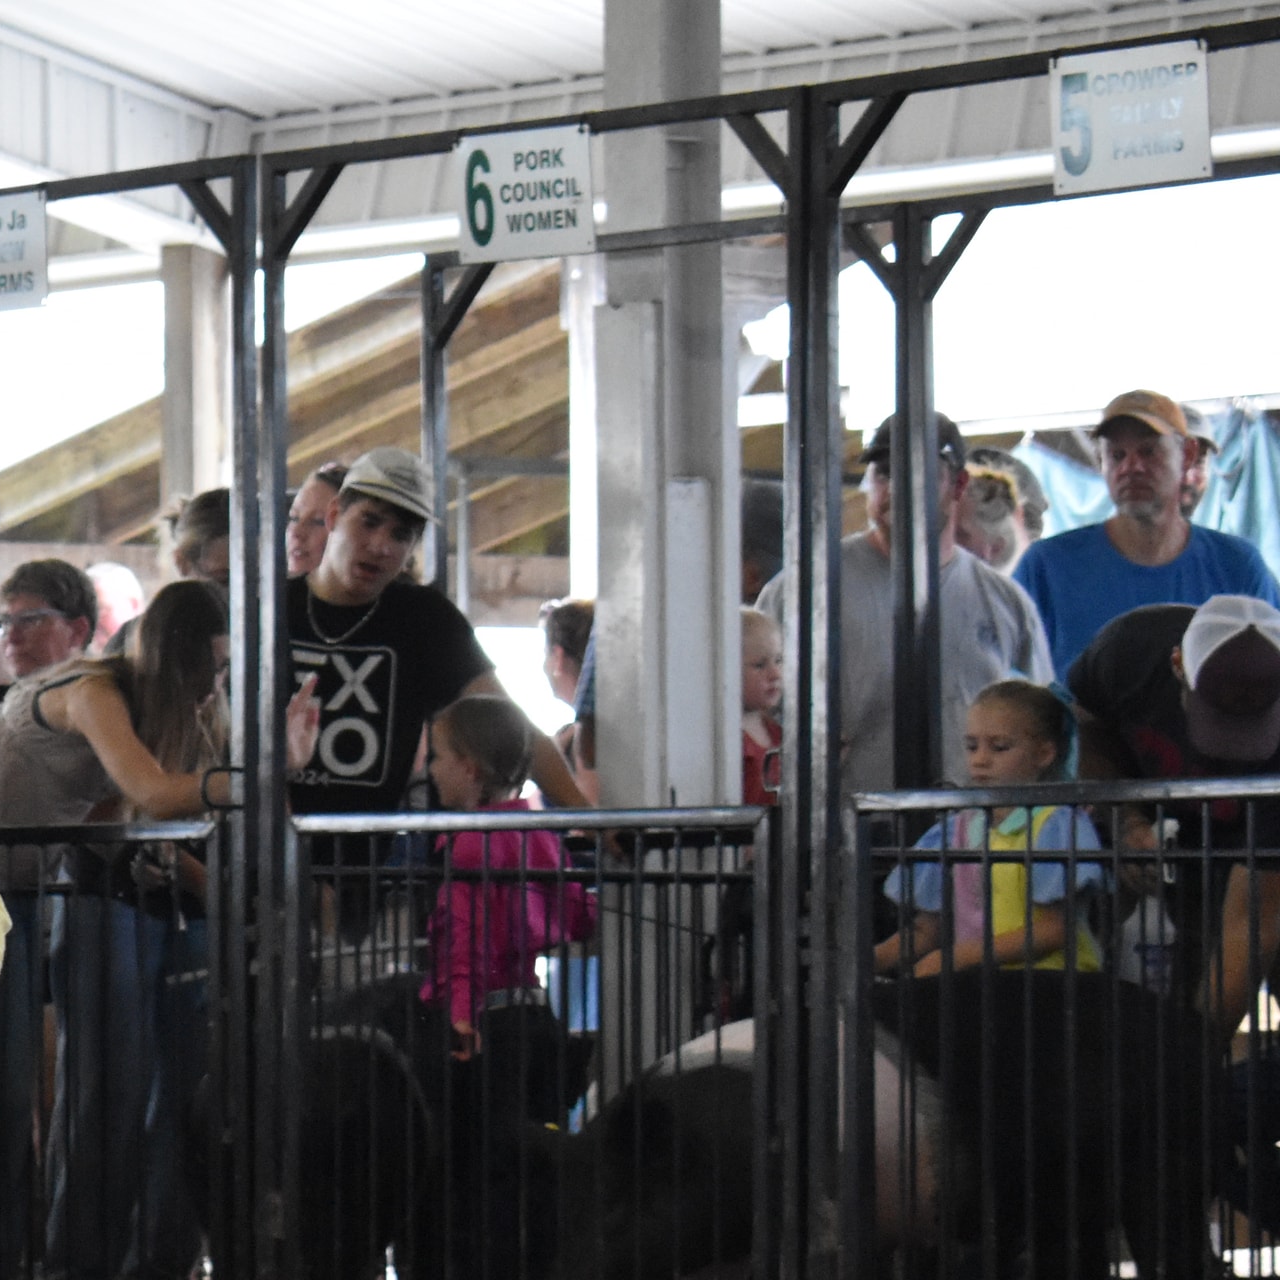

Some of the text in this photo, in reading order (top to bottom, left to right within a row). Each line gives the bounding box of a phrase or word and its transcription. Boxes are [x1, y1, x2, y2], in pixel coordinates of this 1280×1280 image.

[1060, 71, 1093, 177] 5
[513, 147, 564, 172] PORK
[465, 149, 494, 247] 6
[499, 177, 582, 204] COUNCIL
[7, 209, 28, 231] Ja
[506, 208, 576, 233] WOMEN
